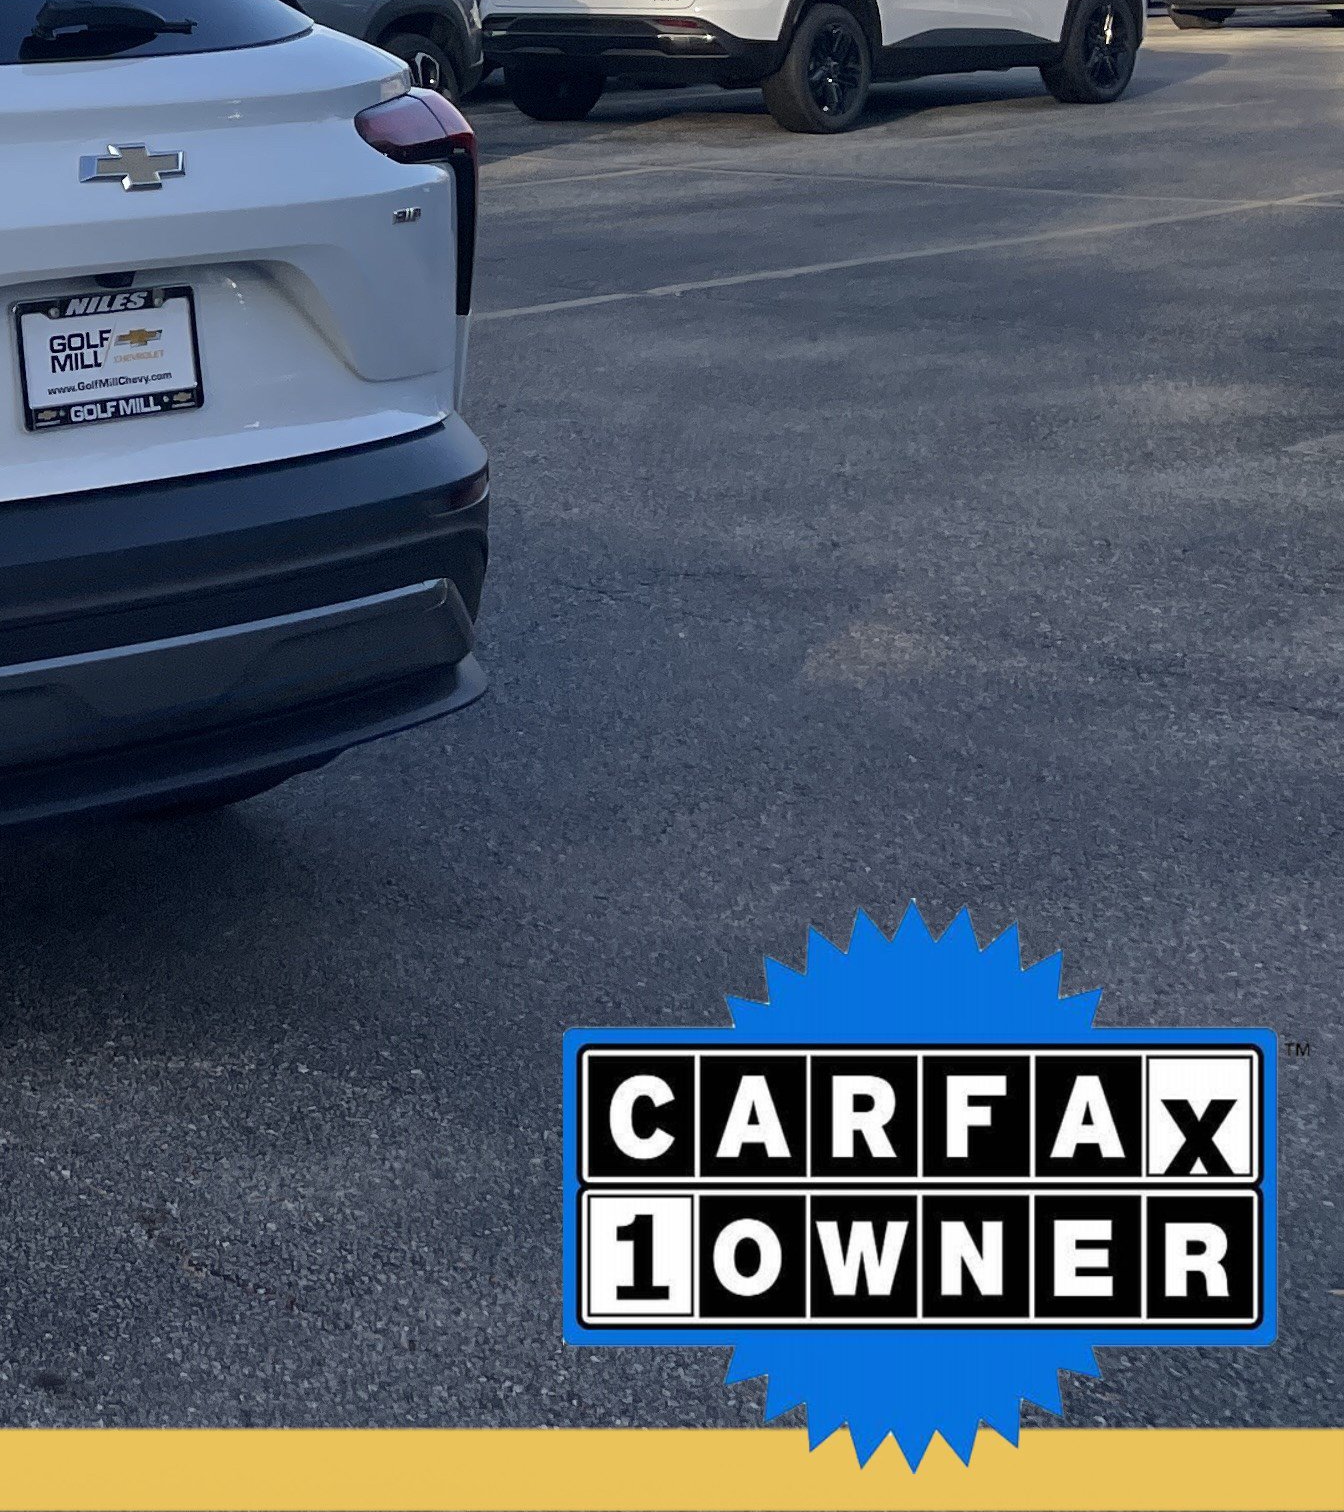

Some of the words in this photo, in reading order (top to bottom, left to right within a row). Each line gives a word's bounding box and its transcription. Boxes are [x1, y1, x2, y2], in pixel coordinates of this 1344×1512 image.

[65, 291, 149, 317] NILES
[49, 328, 111, 354] GOLF
[51, 350, 102, 374] MILL
[47, 371, 173, 395] www.GolfMillChevy.com
[70, 402, 117, 422] GOLF
[119, 396, 161, 416] MILL
